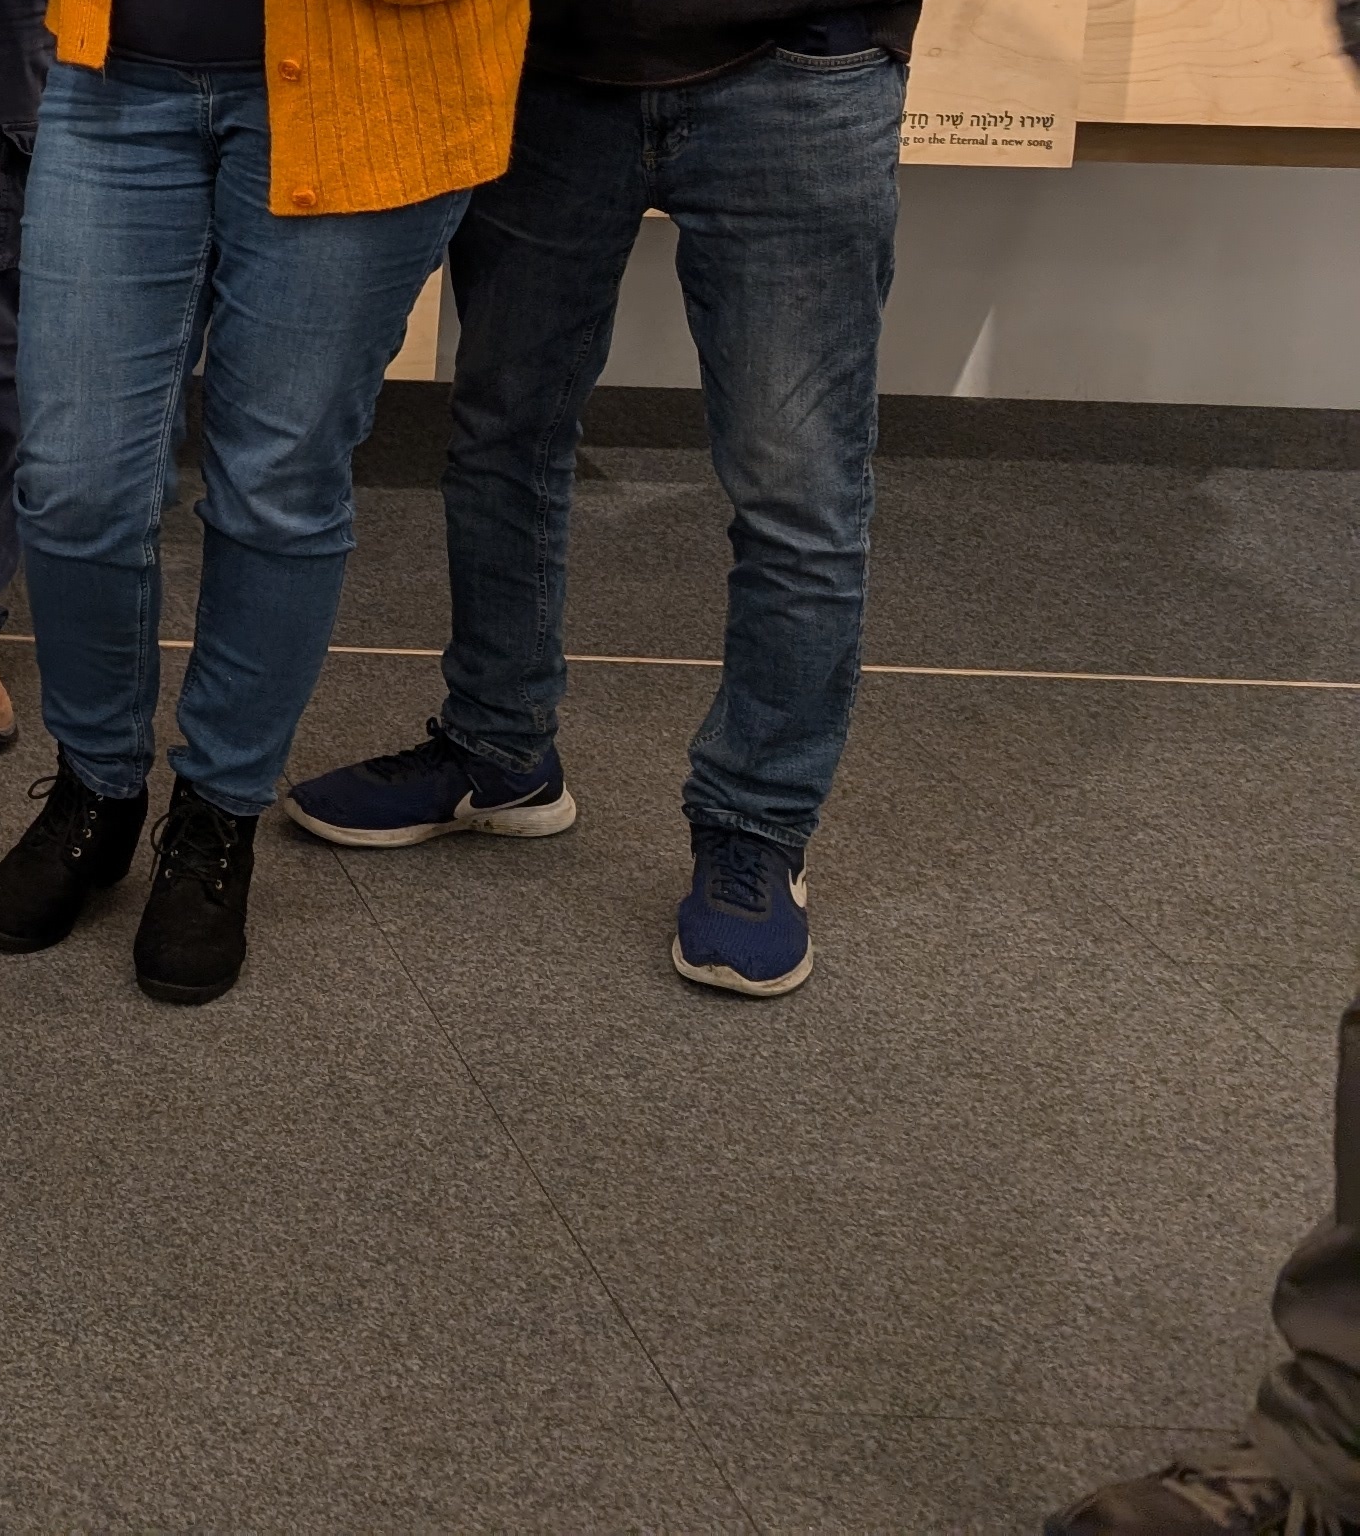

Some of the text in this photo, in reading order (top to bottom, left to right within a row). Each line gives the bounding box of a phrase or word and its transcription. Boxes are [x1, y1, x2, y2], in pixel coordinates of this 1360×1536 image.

[913, 136, 925, 144] to
[928, 132, 946, 145] the
[949, 133, 989, 146] Eternal
[991, 138, 998, 146] a
[1001, 138, 1024, 146] new
[1027, 139, 1054, 150] song
